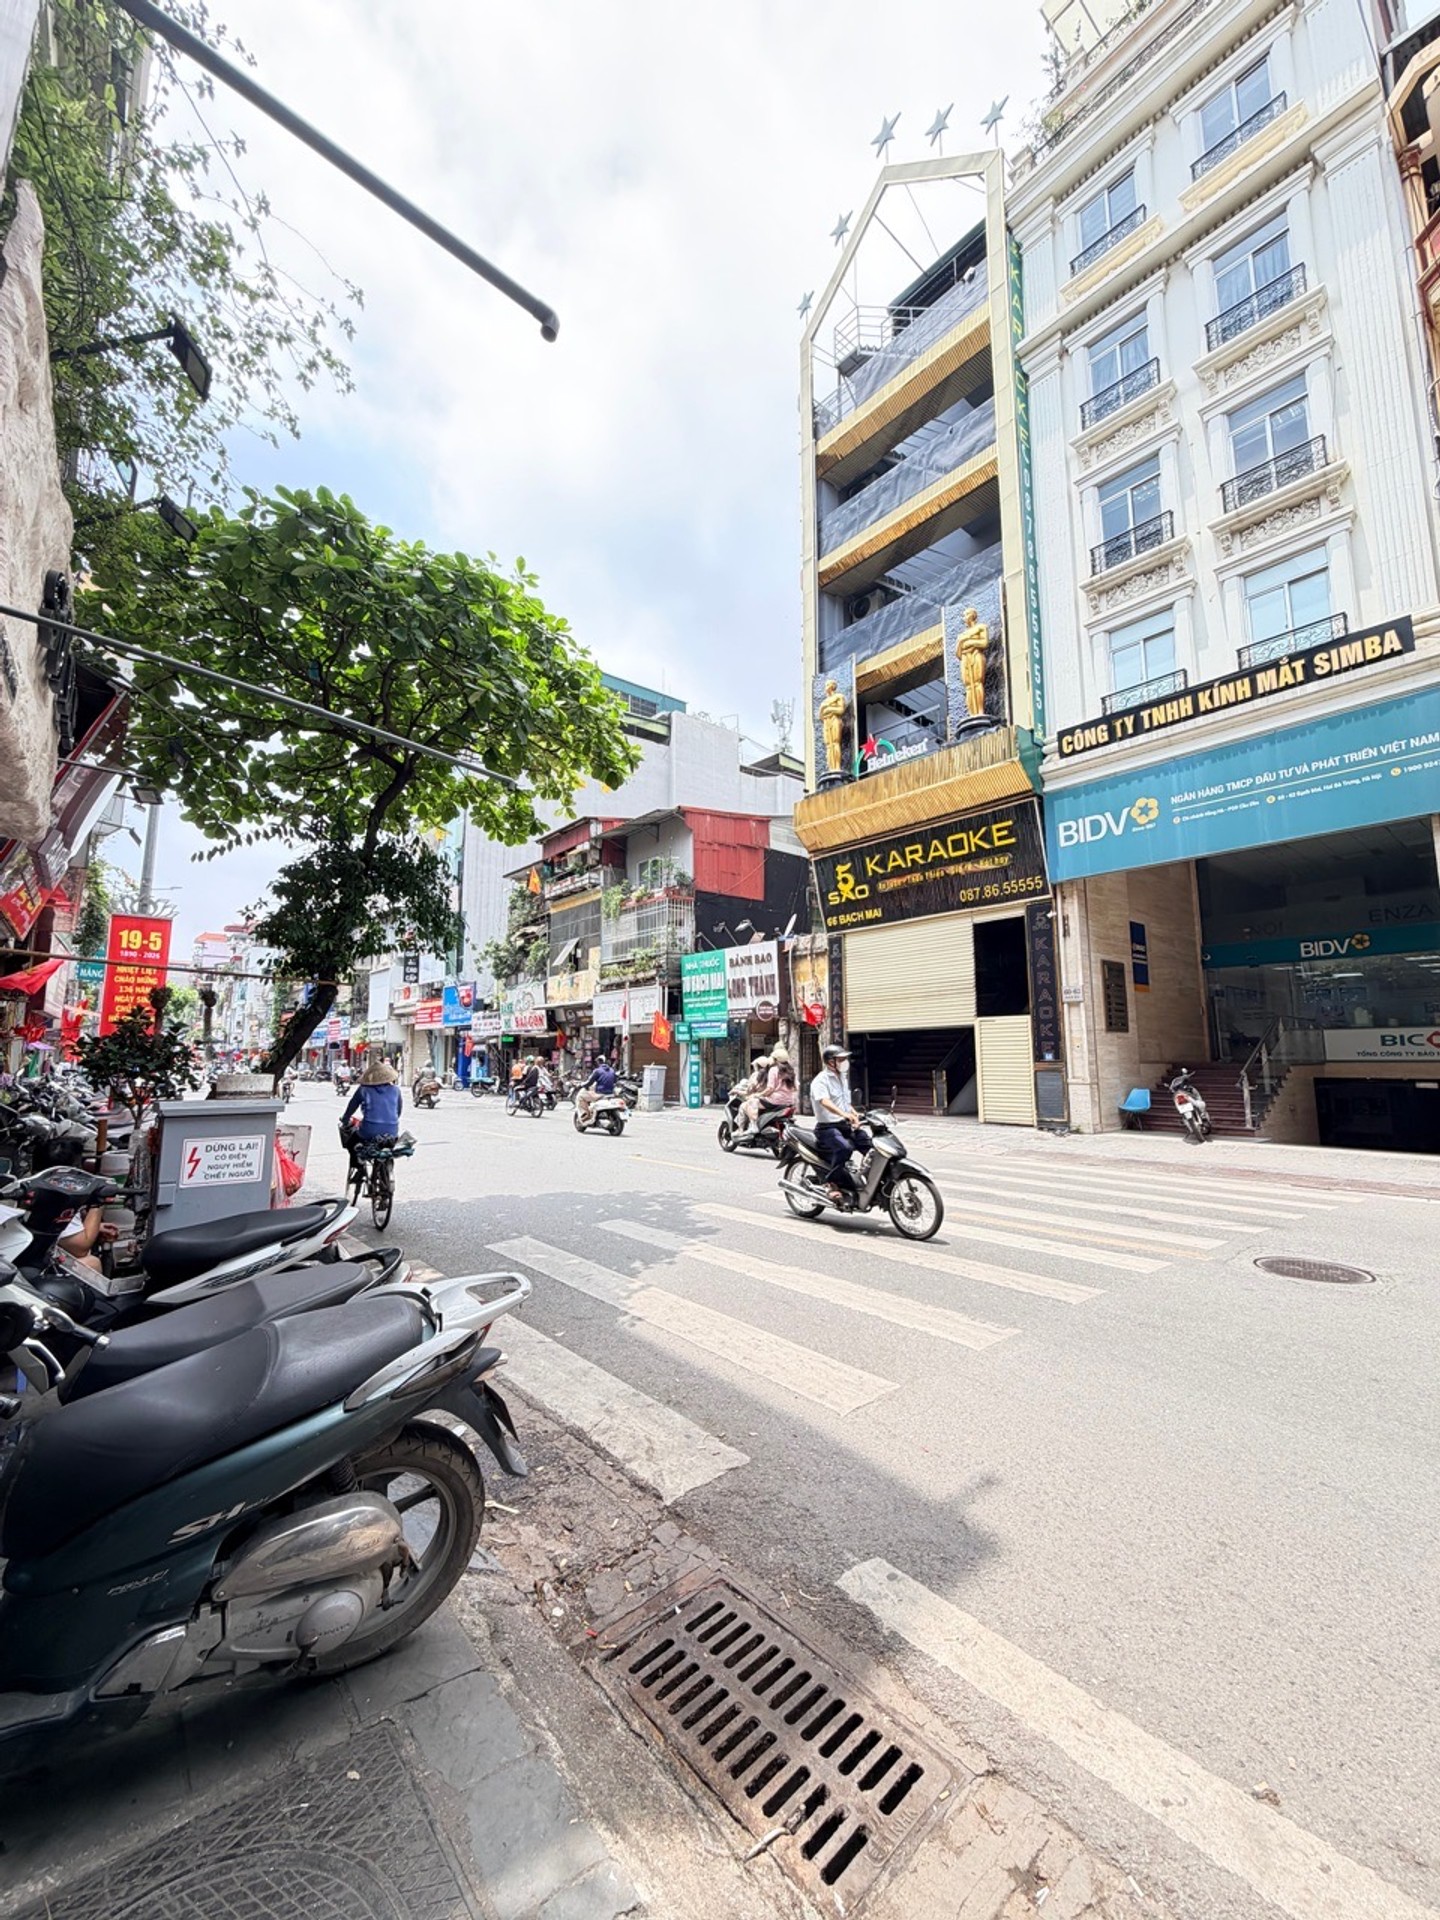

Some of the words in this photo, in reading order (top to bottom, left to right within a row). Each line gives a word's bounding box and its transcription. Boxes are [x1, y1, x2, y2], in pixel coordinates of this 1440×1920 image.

[1010, 261, 1029, 451] KAROKE
[1062, 724, 1110, 754] CÔNG
[1113, 714, 1136, 738] TY
[1140, 696, 1194, 729] TNHH
[1198, 677, 1253, 711] KÍNH
[1256, 654, 1306, 694] MẮT
[1313, 629, 1404, 676] SIMBA
[867, 738, 929, 771] Heineken
[1171, 790, 1196, 805] NGÂN
[1226, 777, 1253, 792] TMCP
[1295, 762, 1310, 775] VÀ
[1379, 738, 1408, 756] VIỆT
[1409, 732, 1440, 749] NAM
[1057, 806, 1131, 848] BIDV
[865, 820, 1017, 876] KARAOKE
[836, 862, 855, 890] 5
[960, 875, 1043, 903] 087.86.55555
[865, 907, 882, 920] MAI
[1368, 904, 1434, 923] ENZA
[119, 929, 162, 951] 19-5
[1300, 937, 1352, 958] BIDV
[831, 963, 842, 1042] KARAOK
[1380, 1033, 1425, 1047] BIC
